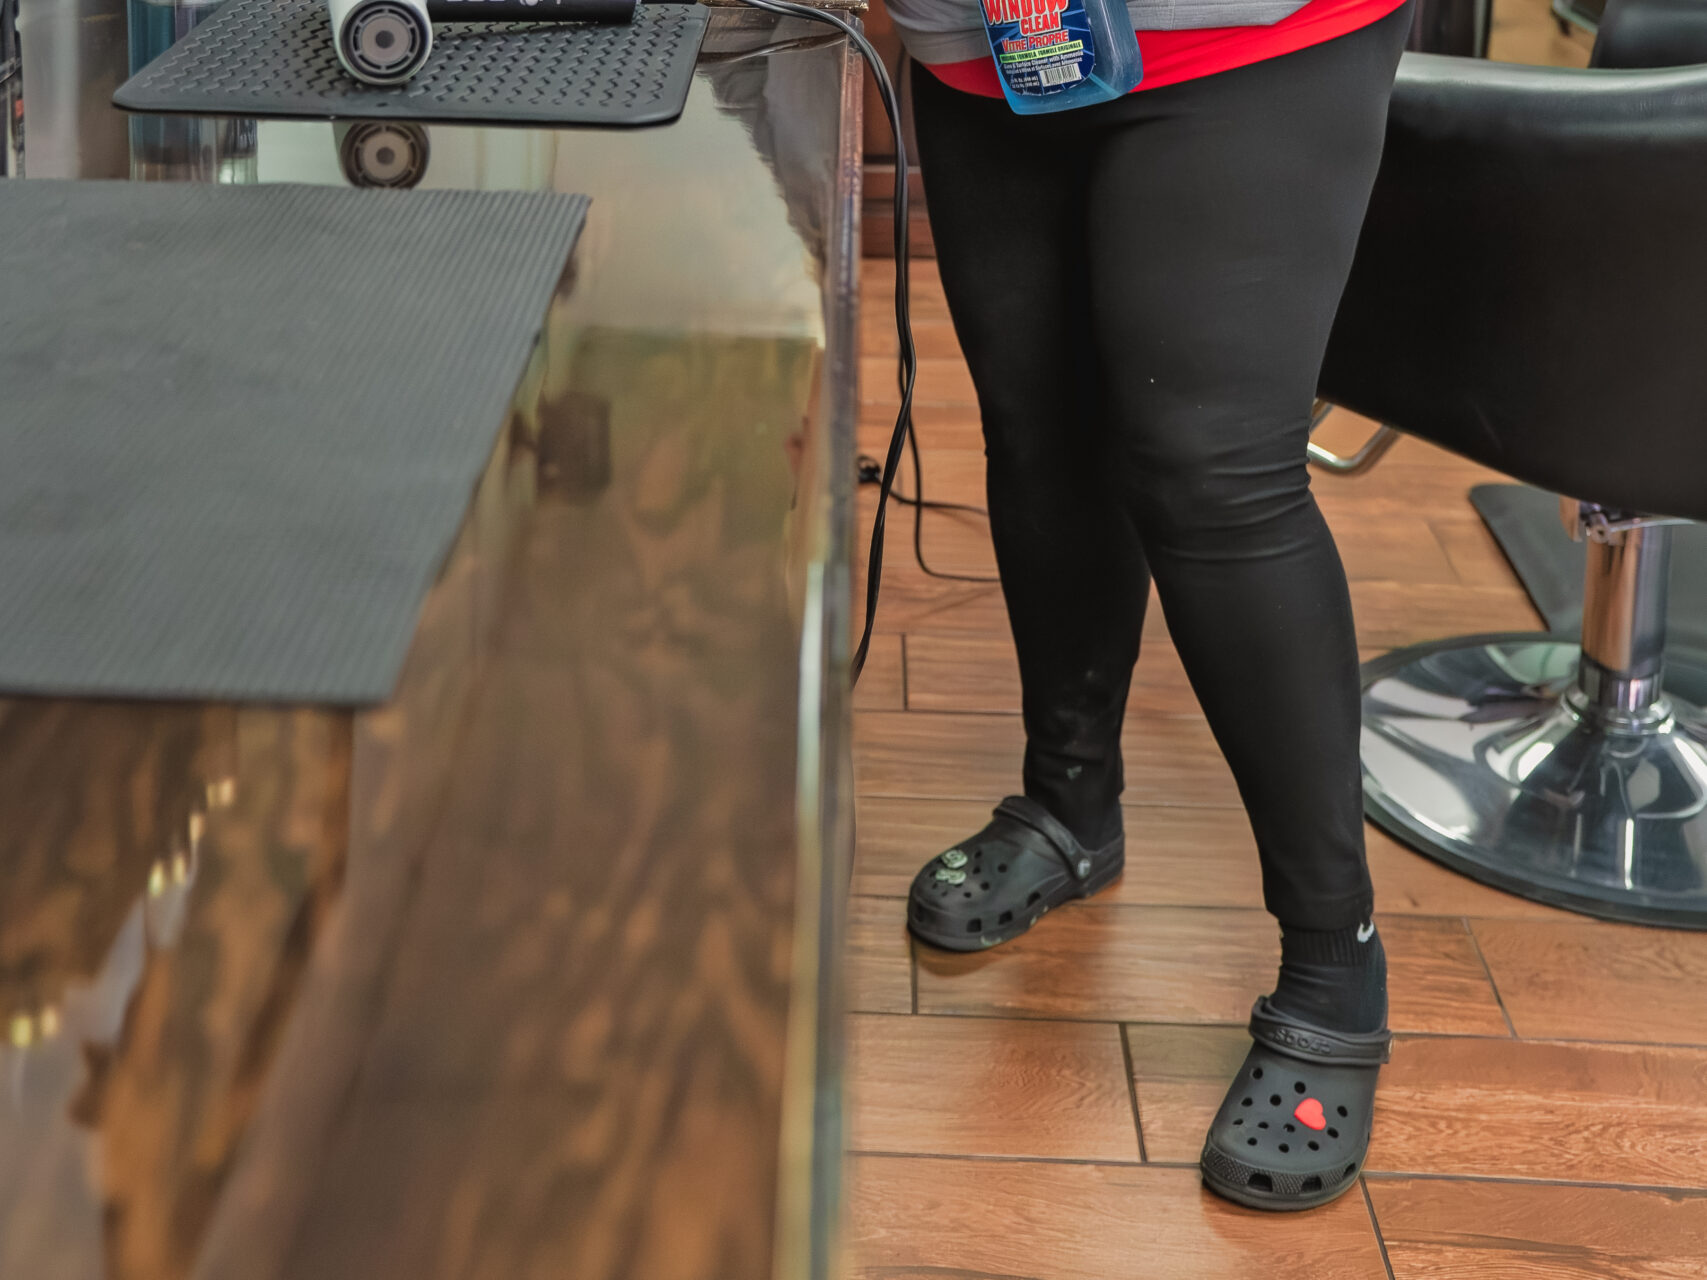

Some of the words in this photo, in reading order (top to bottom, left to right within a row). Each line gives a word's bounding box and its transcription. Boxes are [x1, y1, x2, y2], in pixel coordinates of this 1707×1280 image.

[1020, 11, 1062, 36] CLEAN
[1001, 37, 1027, 53] VITRE
[1028, 29, 1070, 50] PROPRE
